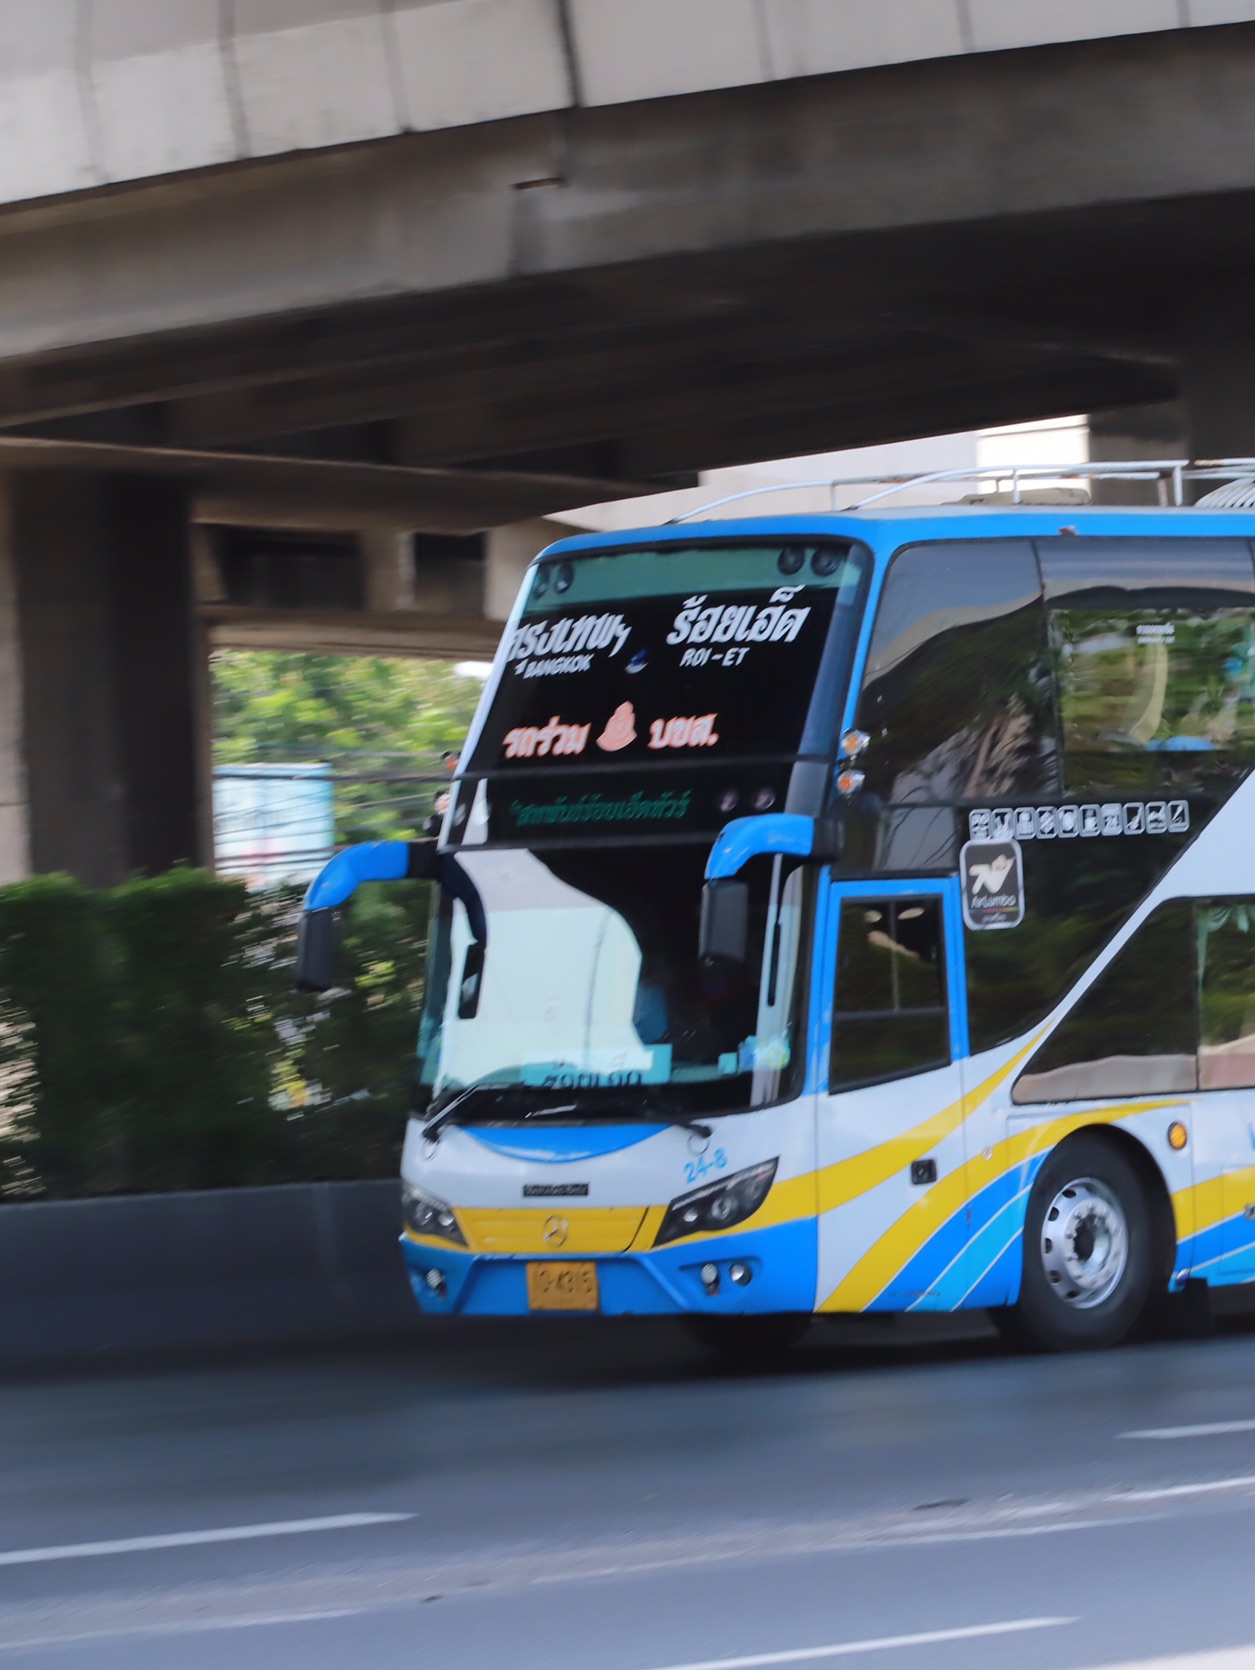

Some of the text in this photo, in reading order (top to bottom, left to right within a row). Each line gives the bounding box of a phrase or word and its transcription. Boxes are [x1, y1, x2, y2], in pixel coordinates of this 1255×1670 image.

[666, 585, 812, 645] ร้อยเอ็ด
[502, 712, 720, 759] รถร่วม บขส.
[683, 1147, 728, 1185] 24-8
